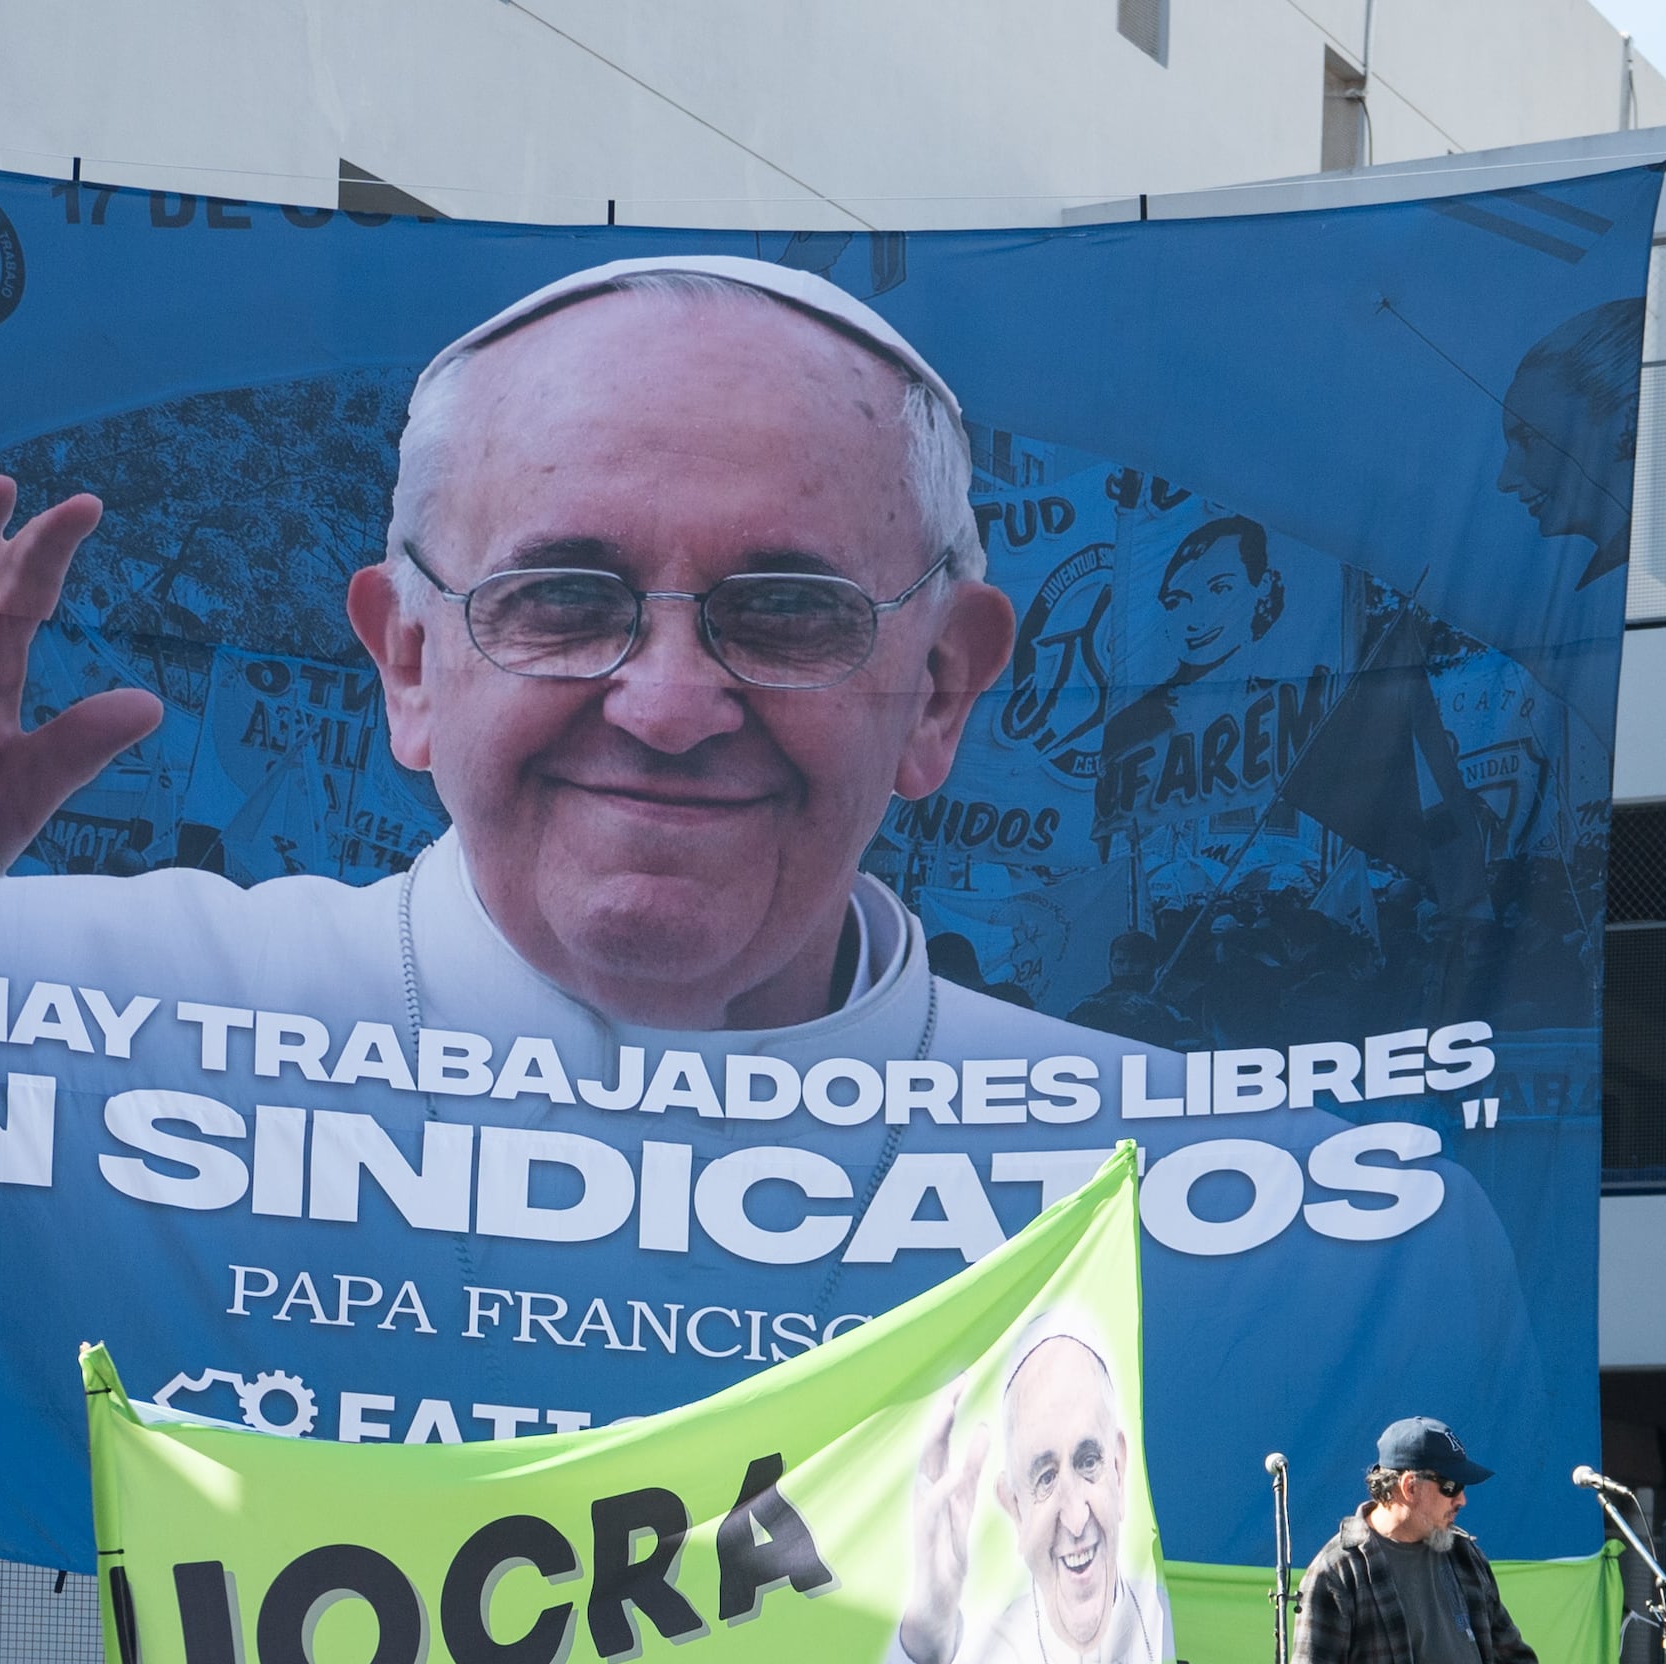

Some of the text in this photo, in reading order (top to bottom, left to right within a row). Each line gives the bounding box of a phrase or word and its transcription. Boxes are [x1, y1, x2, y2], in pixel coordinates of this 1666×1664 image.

[176, 1002, 1102, 1127] TRABAJADORES
[1121, 1020, 1496, 1121] LIBRES
[226, 1263, 877, 1363] PAPA FRANCISC
